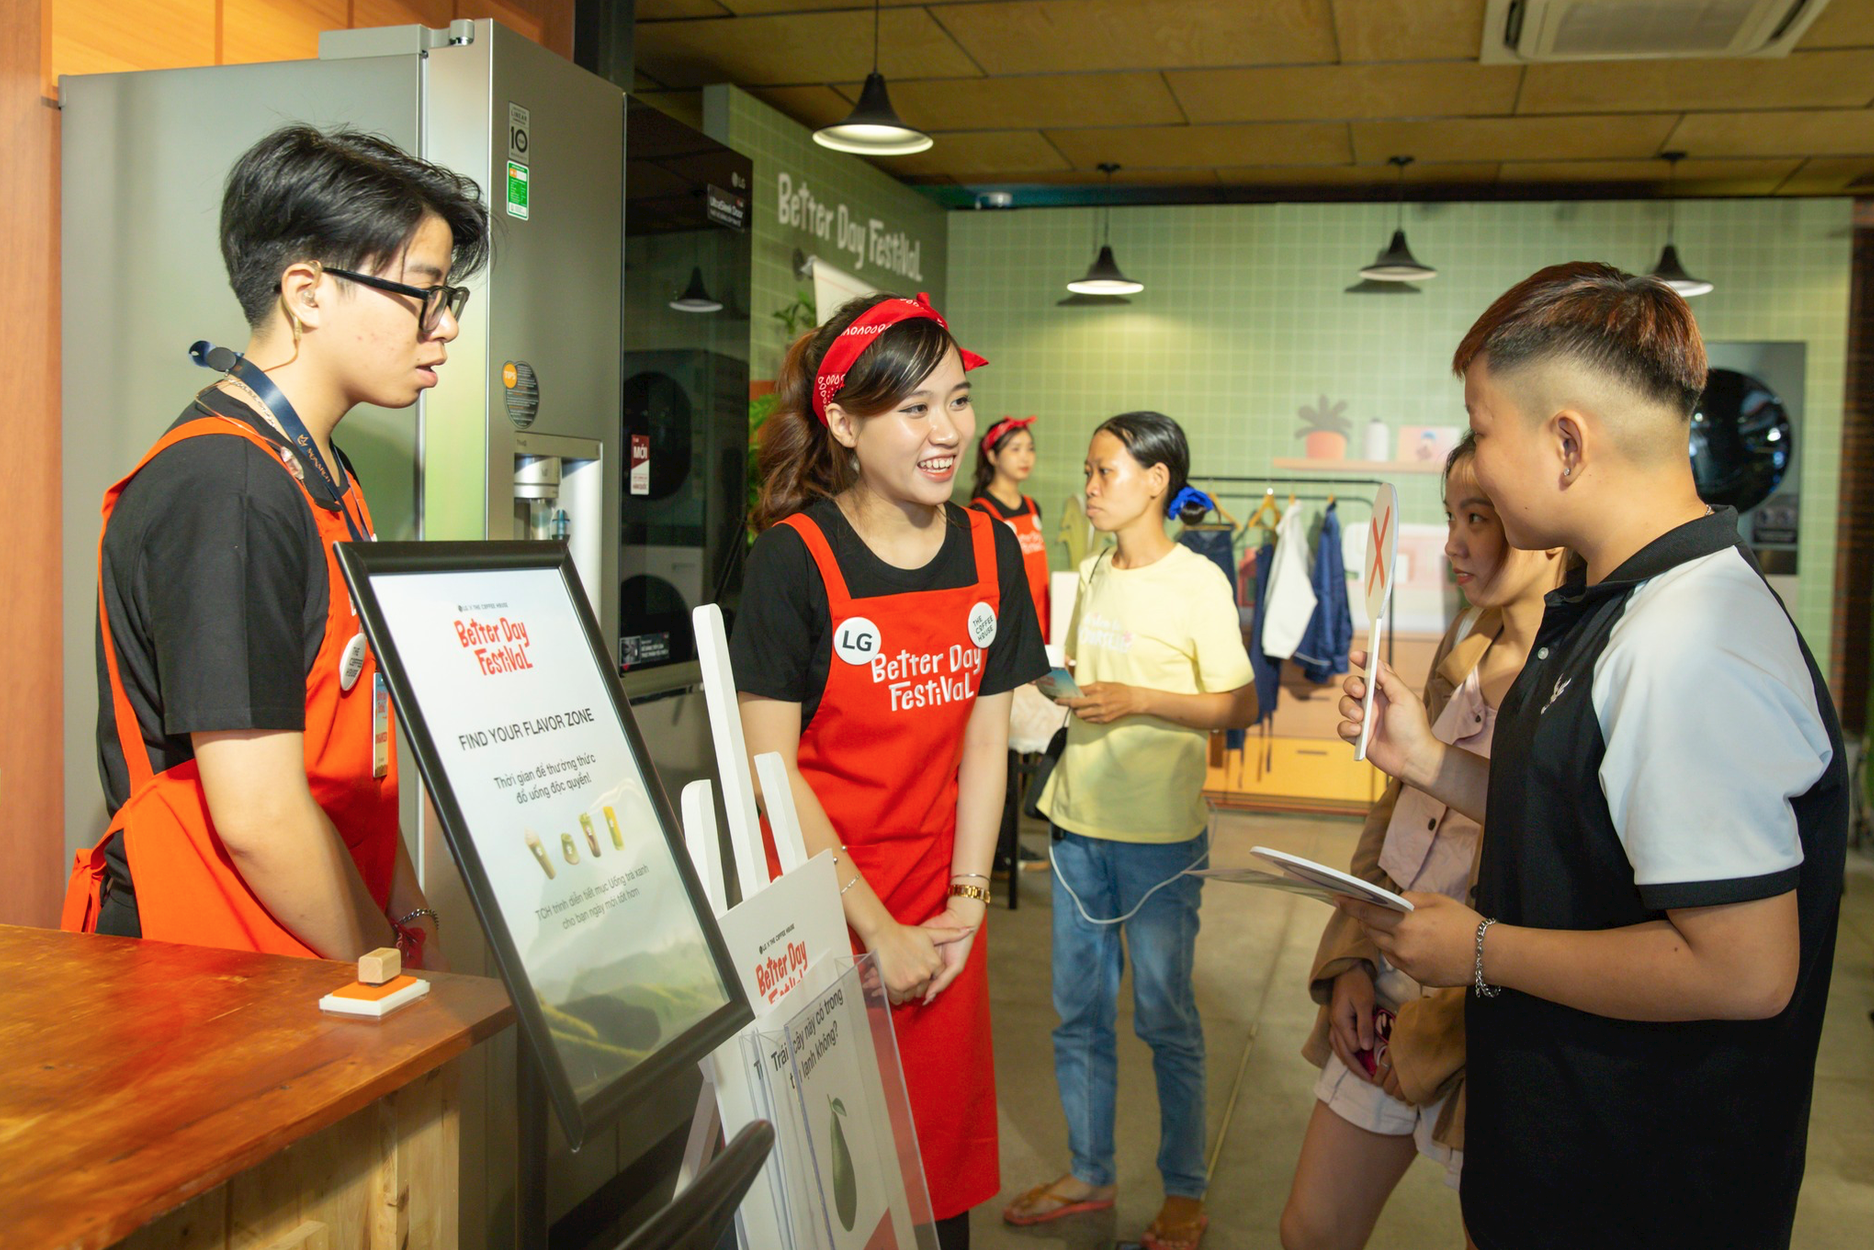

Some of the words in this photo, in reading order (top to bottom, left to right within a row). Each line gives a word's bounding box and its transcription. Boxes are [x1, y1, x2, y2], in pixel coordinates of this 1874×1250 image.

[510, 126, 528, 154] 10
[777, 172, 834, 241] Better
[836, 203, 866, 270] Day
[504, 370, 516, 380] TIPS
[453, 618, 501, 648] Better
[499, 617, 530, 648] Day
[972, 615, 983, 627] THE
[842, 630, 873, 652] LG
[871, 649, 944, 684] Better
[949, 644, 982, 676] Day
[458, 731, 489, 751] FIND
[488, 723, 524, 744] YOUR
[522, 714, 565, 735] FLAVOR
[564, 707, 595, 727] ZONE
[493, 773, 517, 789] Thời
[517, 770, 536, 786] gian
[576, 752, 596, 766] thức
[528, 784, 551, 799] uống
[550, 781, 566, 795] độc
[535, 905, 553, 921] TCH
[607, 875, 627, 889] Uống
[634, 864, 650, 878] xanh
[562, 917, 576, 930] cho
[775, 930, 786, 942] COFFEE
[786, 923, 795, 933] HOUSE
[755, 954, 788, 998] Better
[788, 940, 808, 972] Day
[771, 1042, 789, 1072] Trái
[804, 1017, 816, 1040] này
[824, 989, 844, 1015] trong
[801, 1050, 817, 1080] lạnh
